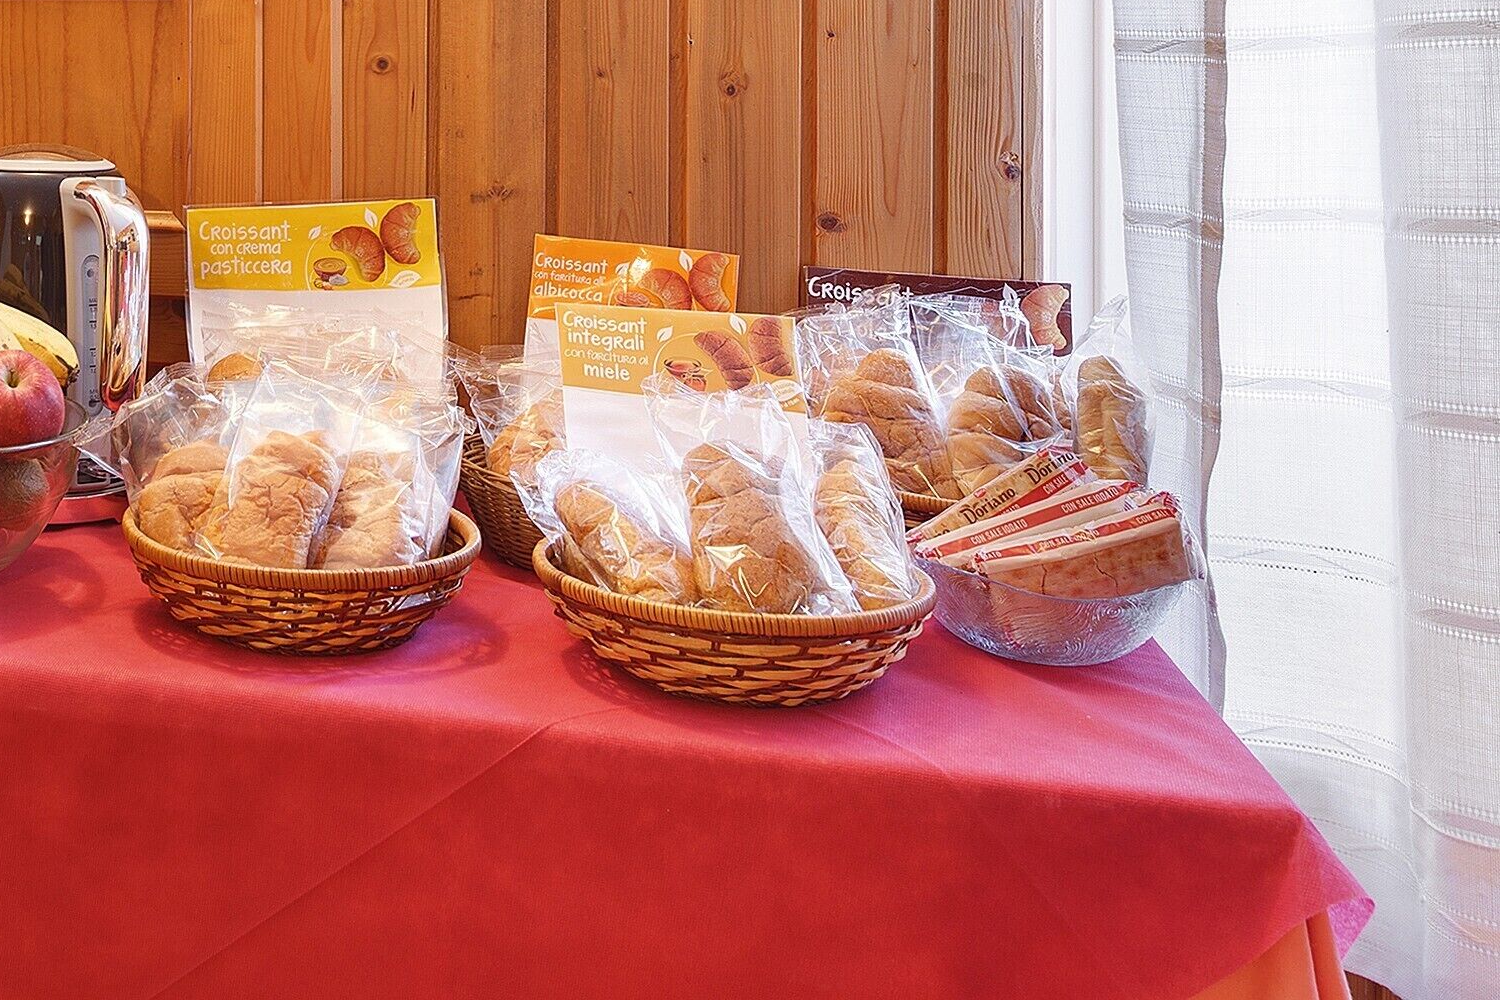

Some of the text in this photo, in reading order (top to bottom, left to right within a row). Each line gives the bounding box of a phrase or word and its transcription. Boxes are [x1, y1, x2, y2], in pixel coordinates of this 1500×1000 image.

[199, 220, 292, 241] Croissant
[210, 241, 282, 255] con crema
[200, 257, 292, 279] pasticcera
[534, 251, 609, 274] Croissant
[534, 271, 549, 279] con
[549, 271, 592, 285] farcitura
[534, 282, 604, 303] albicocca
[562, 310, 648, 335] Croissant
[567, 328, 645, 352] integrali
[564, 348, 649, 366] con farcitura al
[583, 362, 631, 382] miele
[1023, 451, 1075, 486] Dorino
[959, 487, 1017, 525] Doriano
[1062, 486, 1119, 514] CON SALE IODATO
[1136, 514, 1153, 526] CON
[971, 519, 1028, 545] CON SALE IODATO
